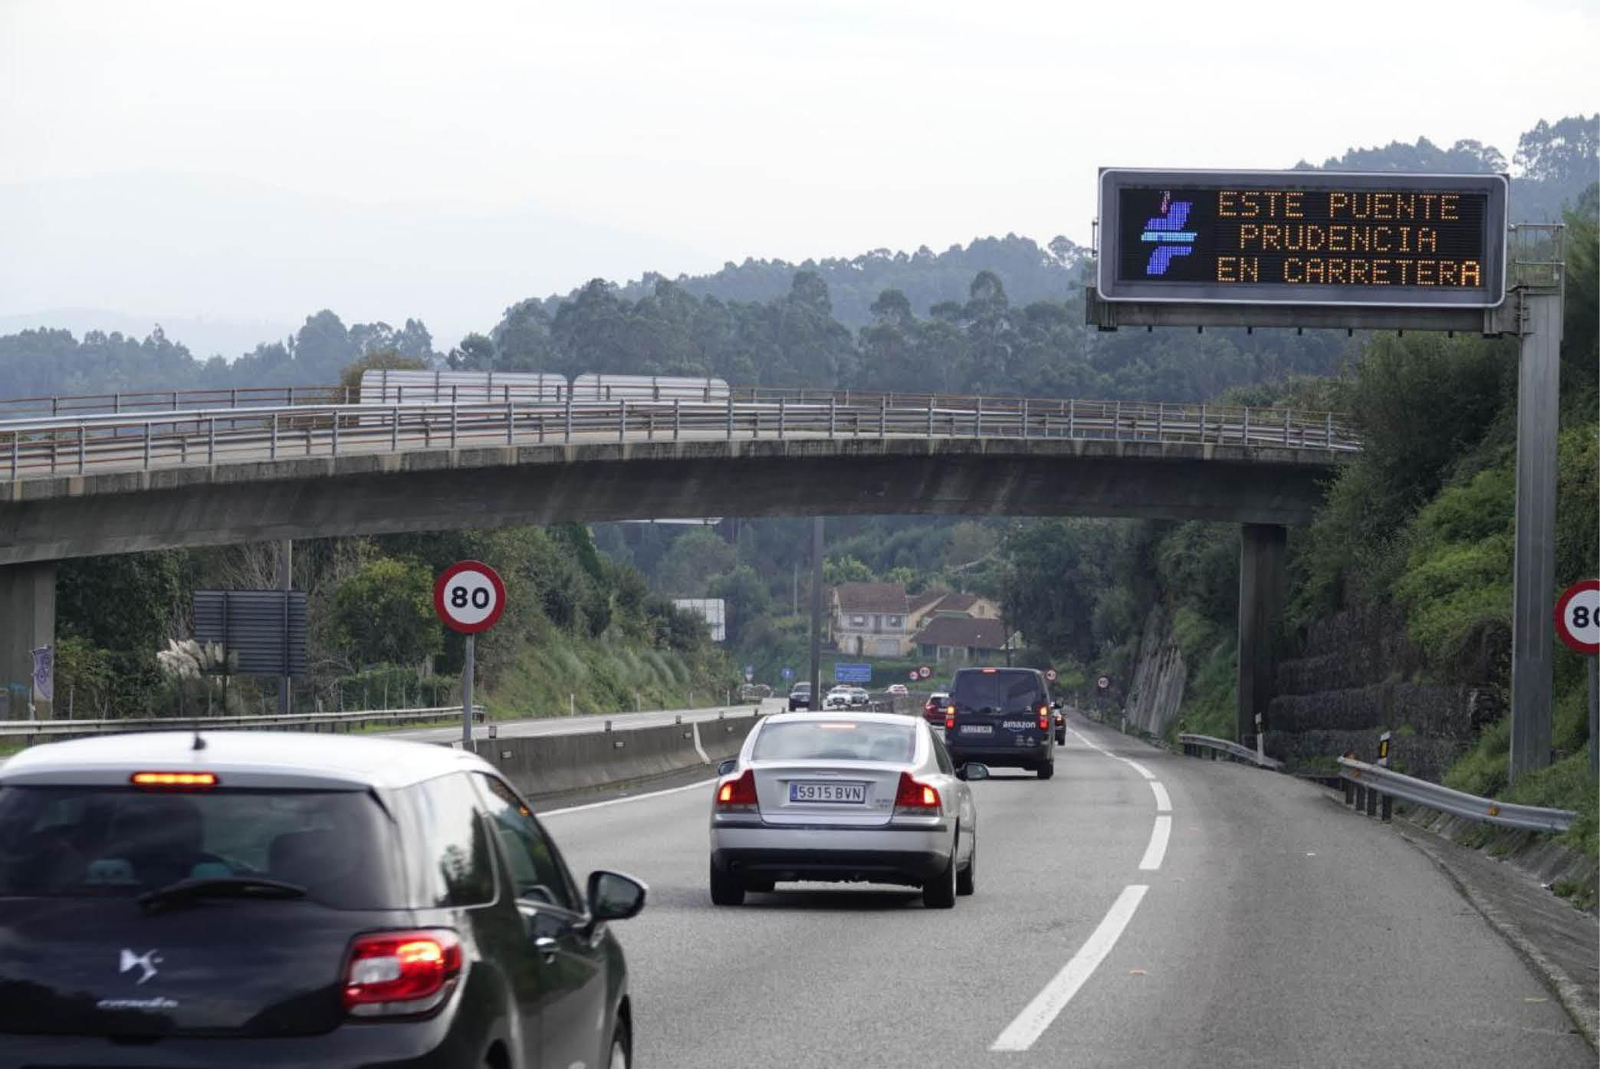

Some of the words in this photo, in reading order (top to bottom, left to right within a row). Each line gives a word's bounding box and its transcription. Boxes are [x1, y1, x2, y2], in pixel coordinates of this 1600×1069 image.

[1218, 190, 1304, 218] ESTE
[1329, 192, 1460, 220] PUENTE
[1239, 224, 1437, 253] PRUDENCIA
[1217, 256, 1259, 283] EN
[1283, 257, 1481, 287] CARRETERA
[451, 586, 490, 609] 80
[1002, 720, 1036, 729] amazon
[798, 786, 832, 799] 5915
[835, 787, 861, 800] BVN
